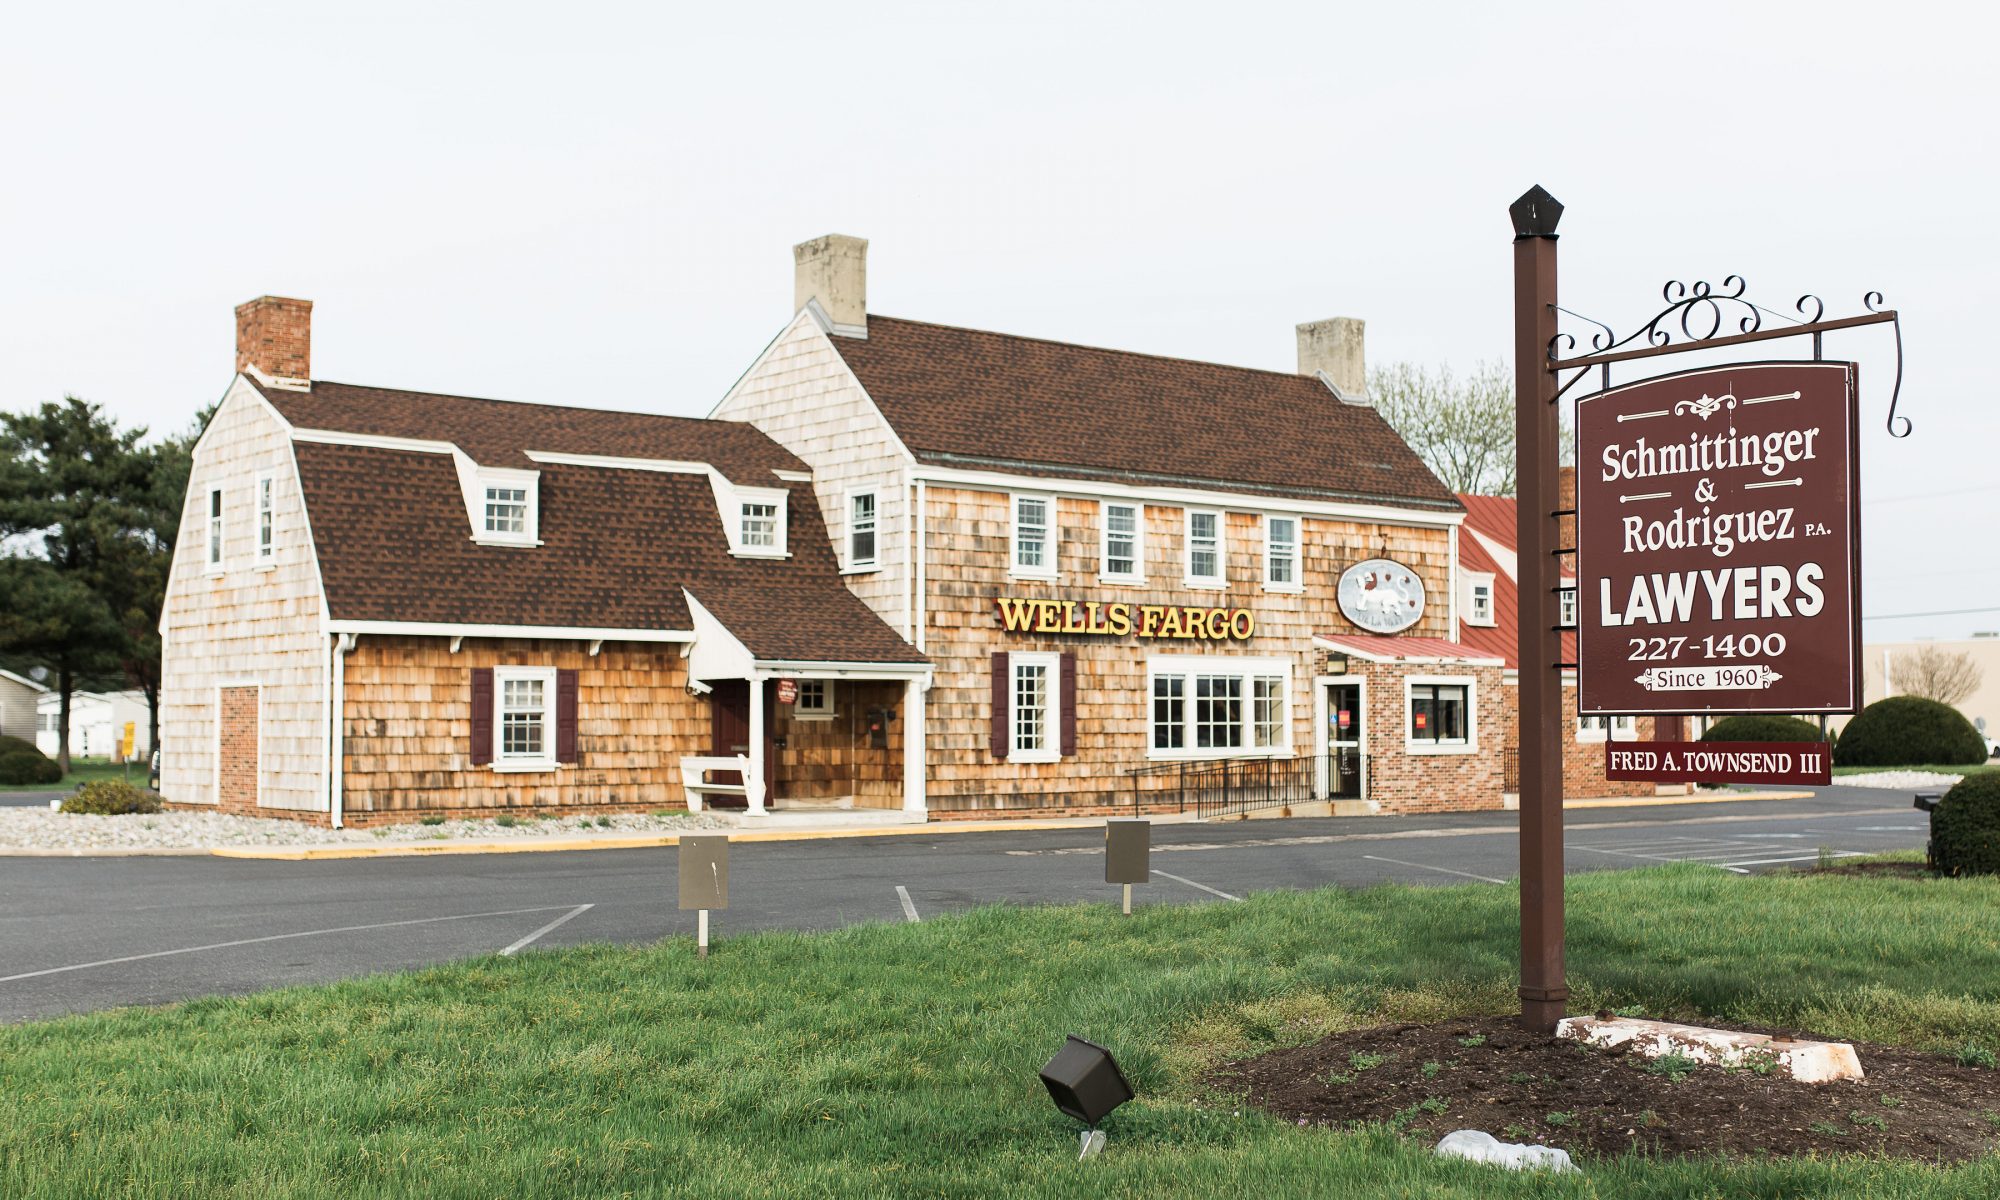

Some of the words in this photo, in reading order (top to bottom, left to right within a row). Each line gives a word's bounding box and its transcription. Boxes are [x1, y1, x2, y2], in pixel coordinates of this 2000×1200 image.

[1602, 426, 1820, 482] Schmittinger
[1694, 477, 1718, 503] &
[1623, 506, 1795, 557] Rodriguez
[1805, 523, 1832, 537] P.A.
[1600, 562, 1825, 627] LAWYERS
[996, 597, 1131, 636] WELLS
[1138, 605, 1256, 641] FARGO
[1628, 632, 1787, 661] 227-1400
[1657, 670, 1705, 688] Since
[1715, 669, 1758, 686] 1960
[1610, 751, 1658, 771] FRED
[1662, 752, 1681, 772] A.
[1683, 751, 1792, 774] TOWNSEND
[1799, 753, 1822, 774] III
